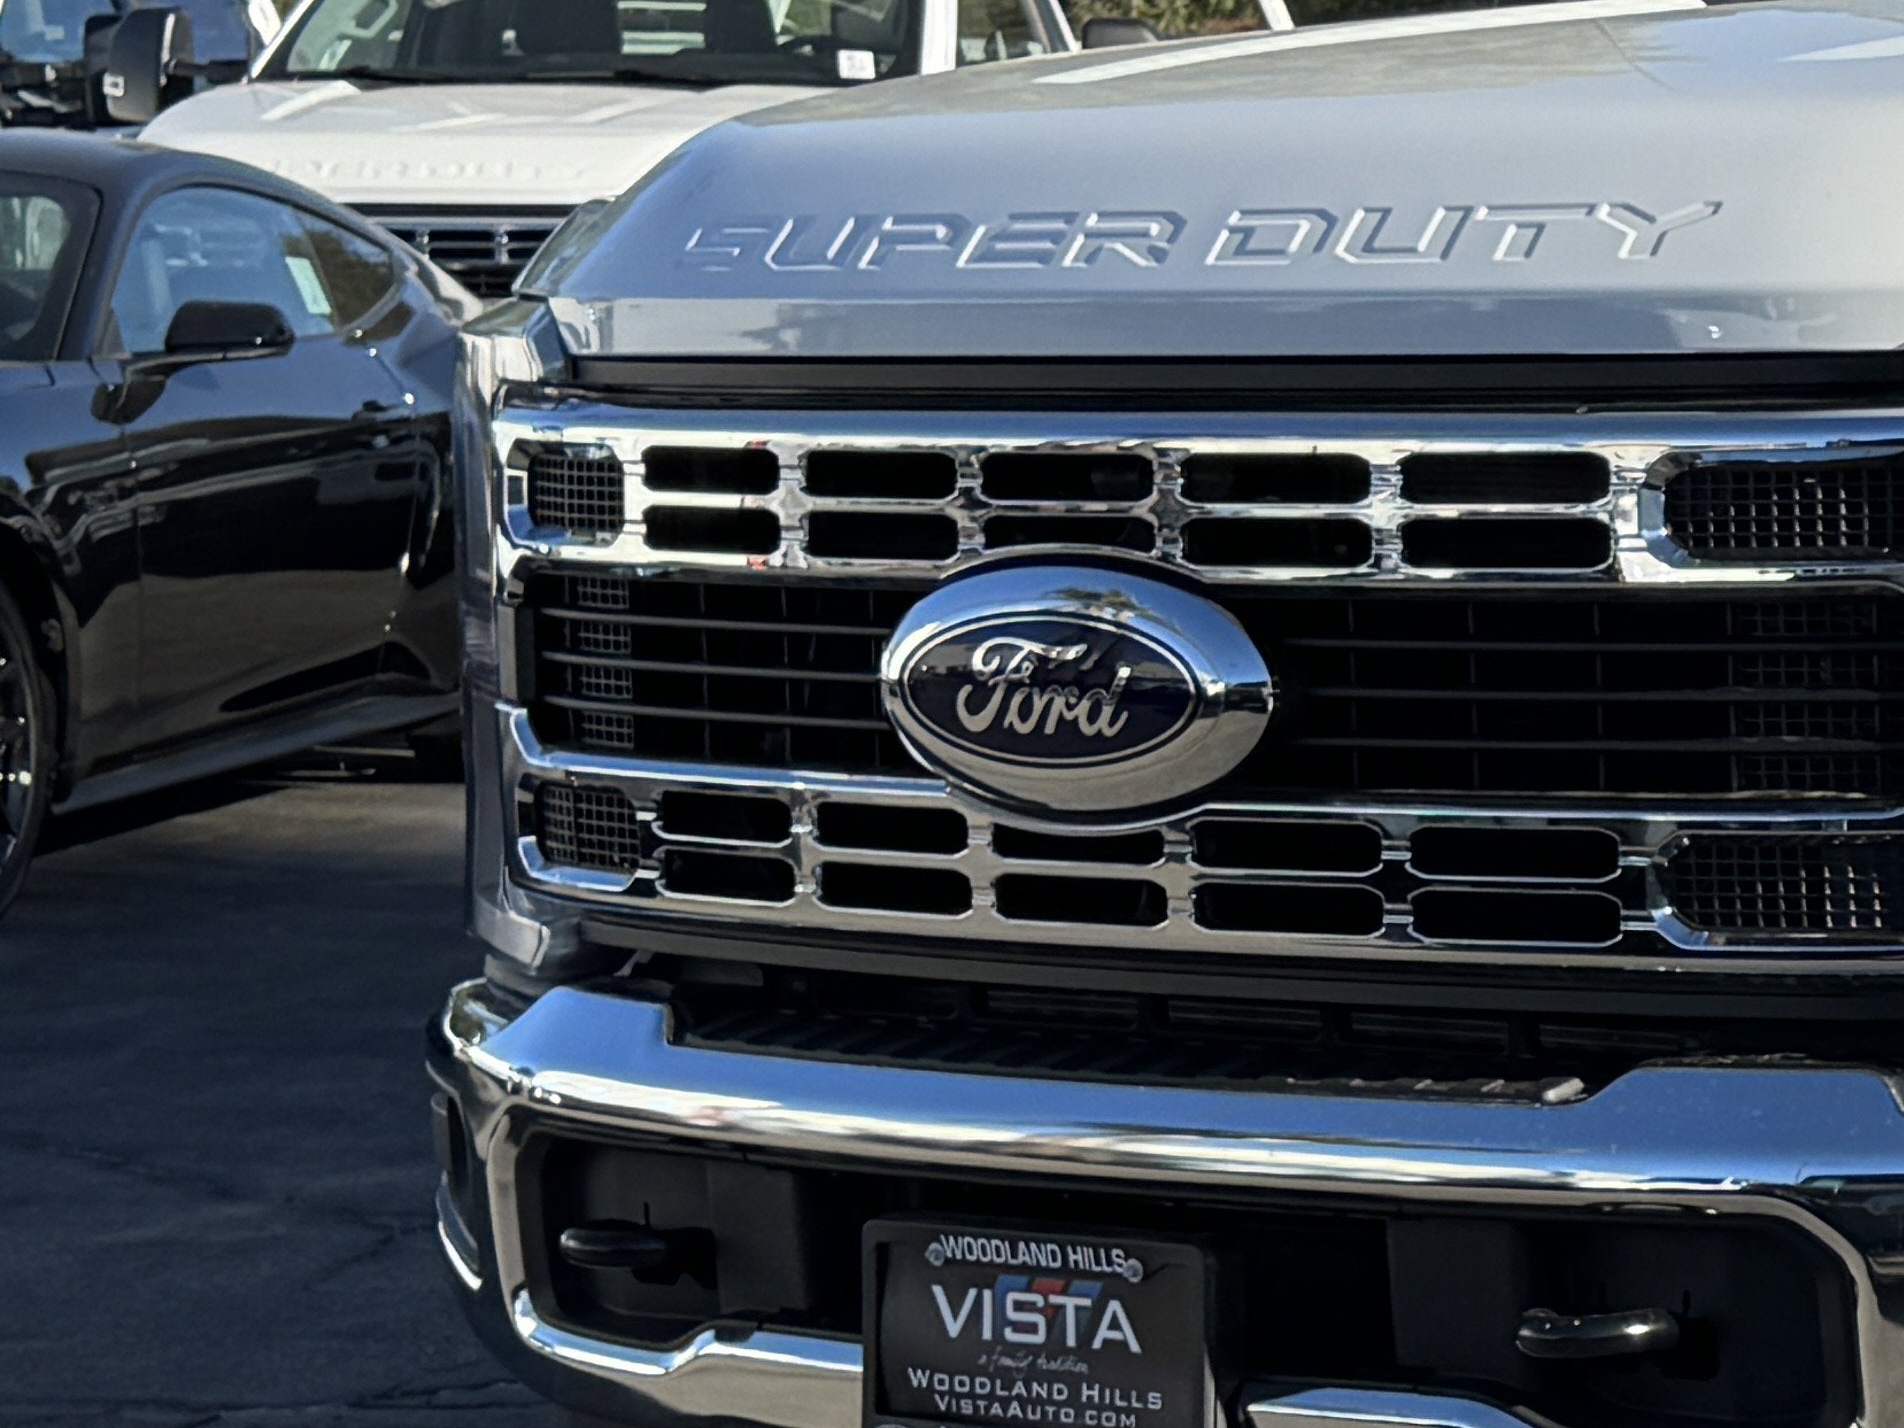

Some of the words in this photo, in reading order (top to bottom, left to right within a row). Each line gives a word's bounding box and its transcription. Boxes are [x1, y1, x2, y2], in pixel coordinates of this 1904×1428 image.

[684, 210, 1188, 272] SUPER
[1204, 200, 1725, 268] DUTY
[956, 637, 1132, 738] Ford
[940, 1234, 1062, 1269] WOODLAND
[1067, 1245, 1128, 1274] HILLS
[931, 1284, 1142, 1355] VISTA
[907, 1366, 1069, 1401] WOODLAND
[1081, 1383, 1163, 1411] HILLS
